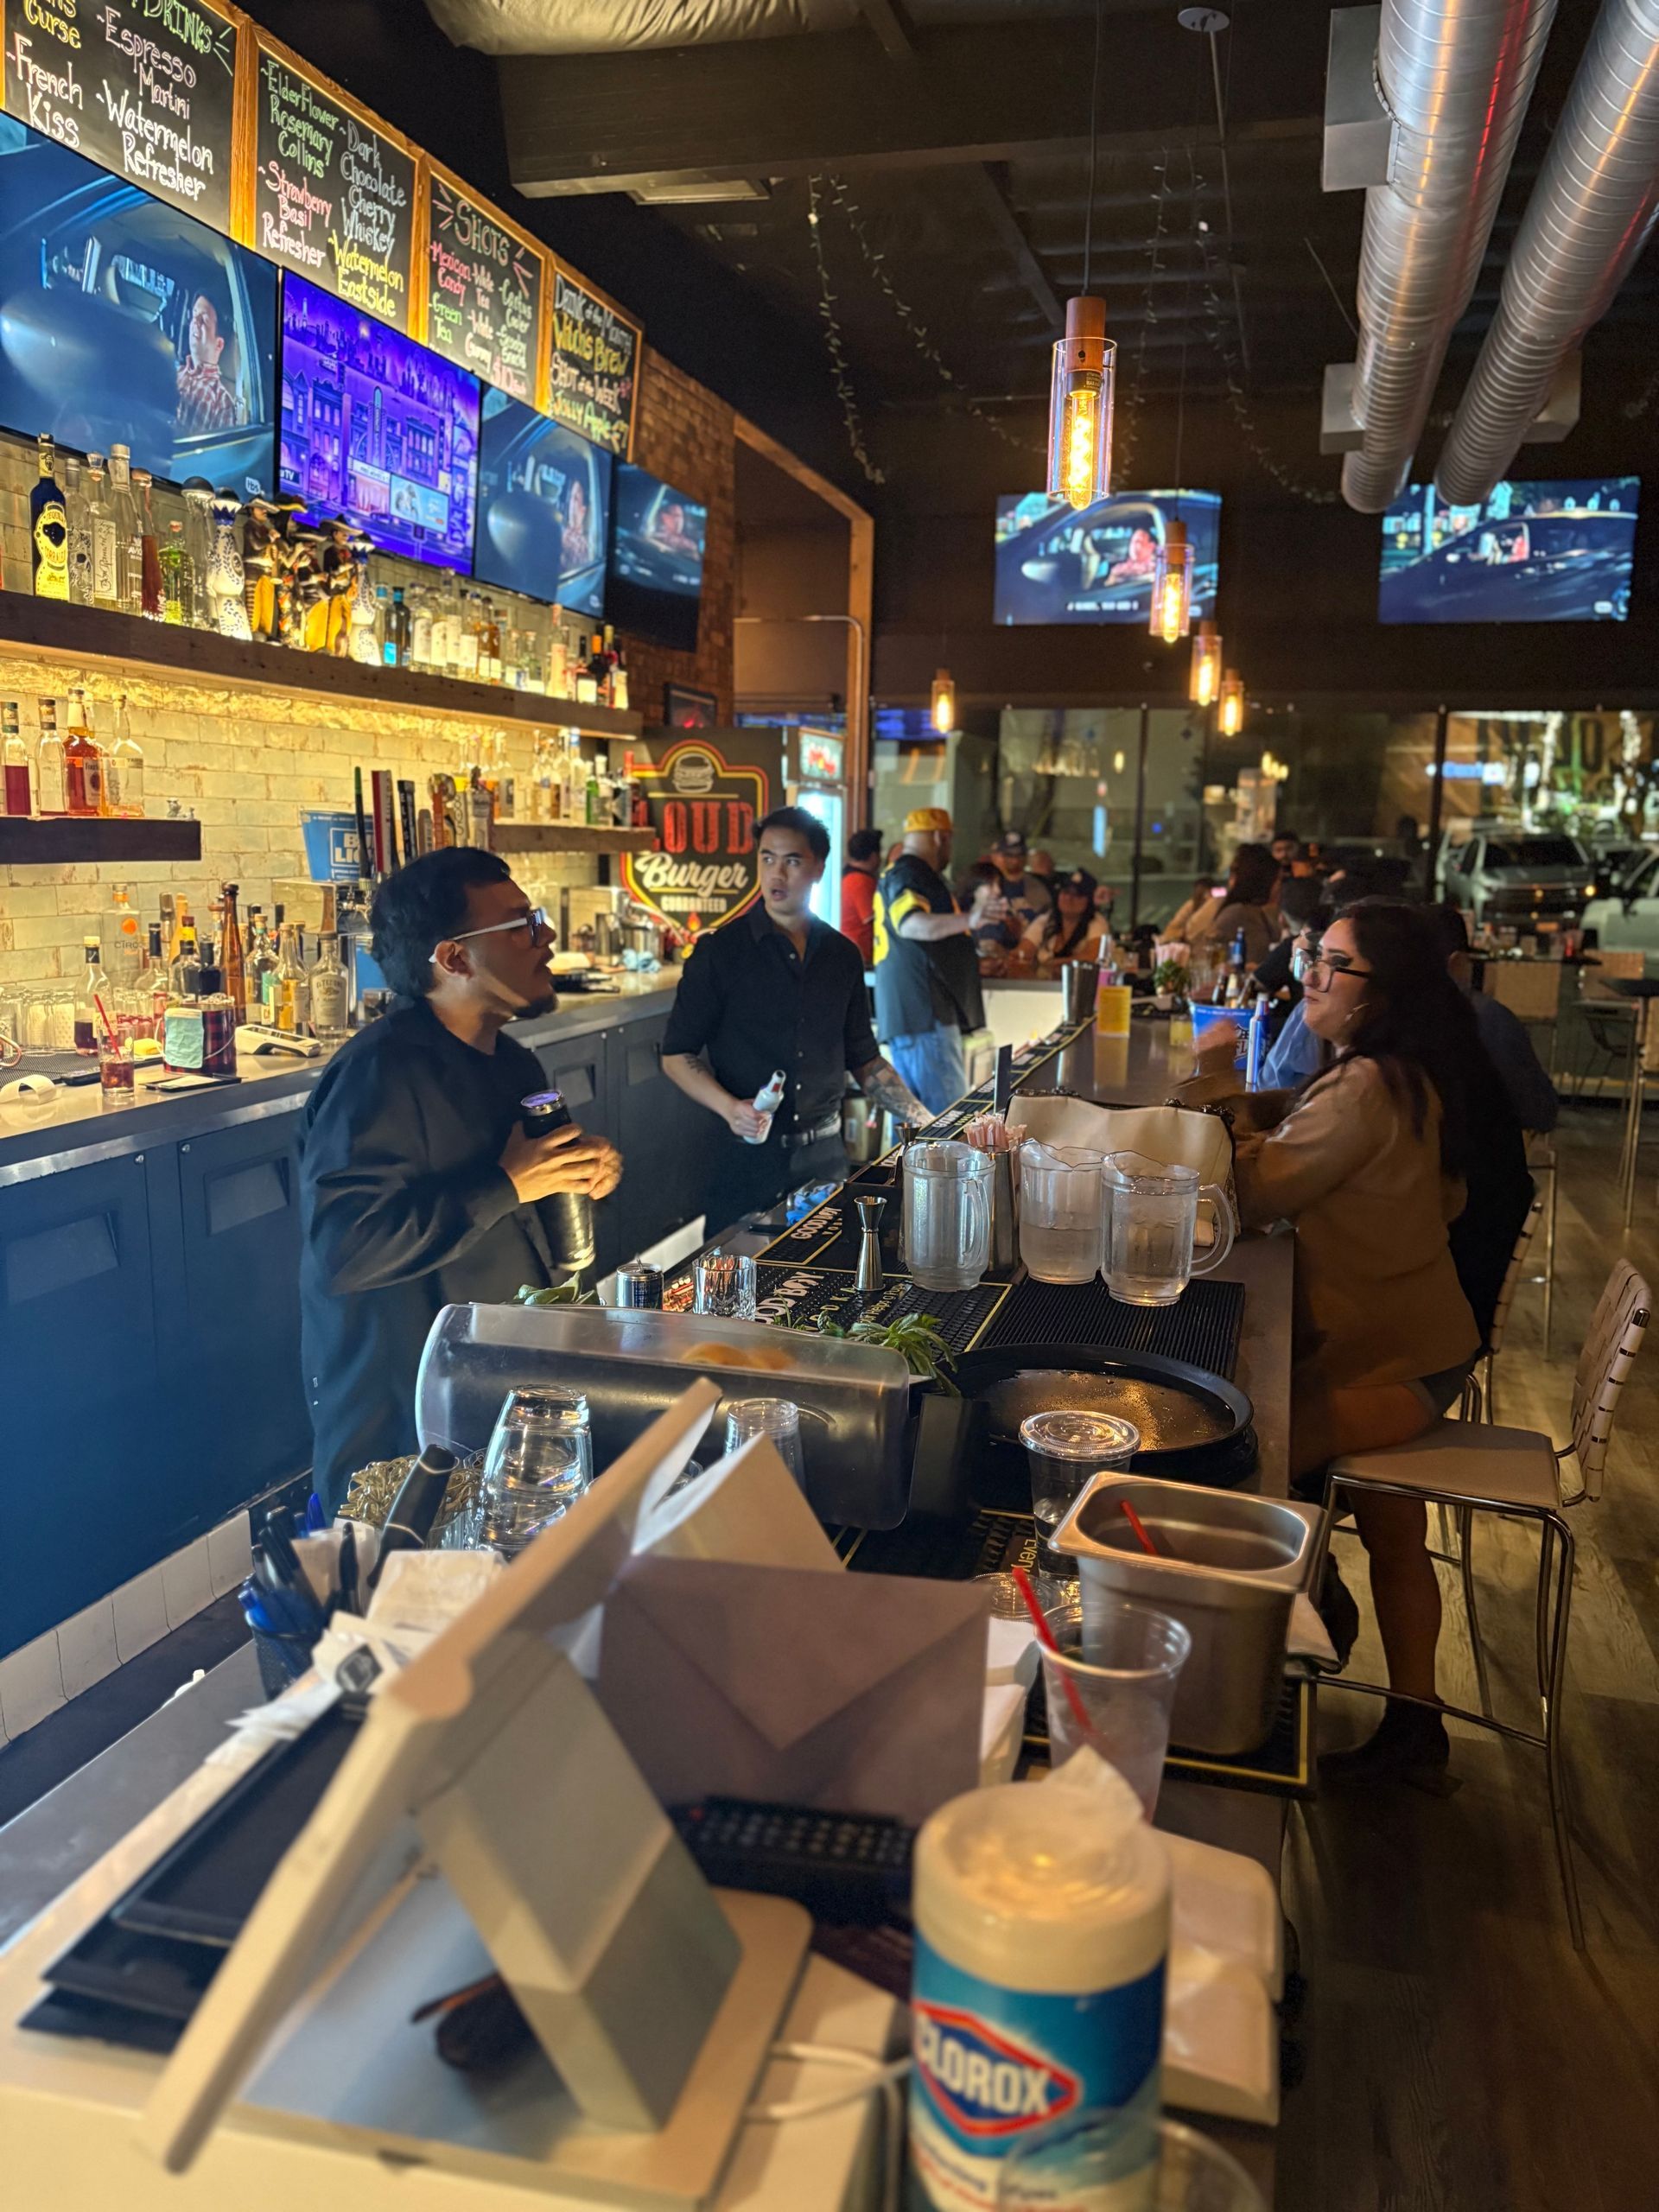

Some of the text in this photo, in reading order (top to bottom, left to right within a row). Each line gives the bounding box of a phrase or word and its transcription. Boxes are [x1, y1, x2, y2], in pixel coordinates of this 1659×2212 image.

[24, 0, 81, 48] Curse
[105, 5, 197, 88] Espresso
[14, 32, 83, 110] French
[139, 62, 190, 119] Martini
[26, 82, 79, 149] Kiss
[103, 79, 214, 175] Watermelon
[270, 93, 334, 166] Rosemary
[122, 131, 207, 201] Refresher
[278, 130, 324, 178] Collins
[348, 119, 381, 170] Dark
[265, 160, 332, 228] Strawberry
[340, 151, 407, 207] Chocolate
[262, 211, 327, 268] Refresher
[277, 194, 312, 231] Basil
[341, 197, 395, 264] Whiskey
[349, 184, 396, 238] Cherry
[454, 200, 511, 266] SHOTS
[332, 229, 404, 293] Watermelon
[437, 266, 467, 307] Candy
[432, 291, 462, 326] Green
[434, 315, 453, 344] Tea
[652, 802, 753, 854] OUD
[634, 849, 749, 897] Burger
